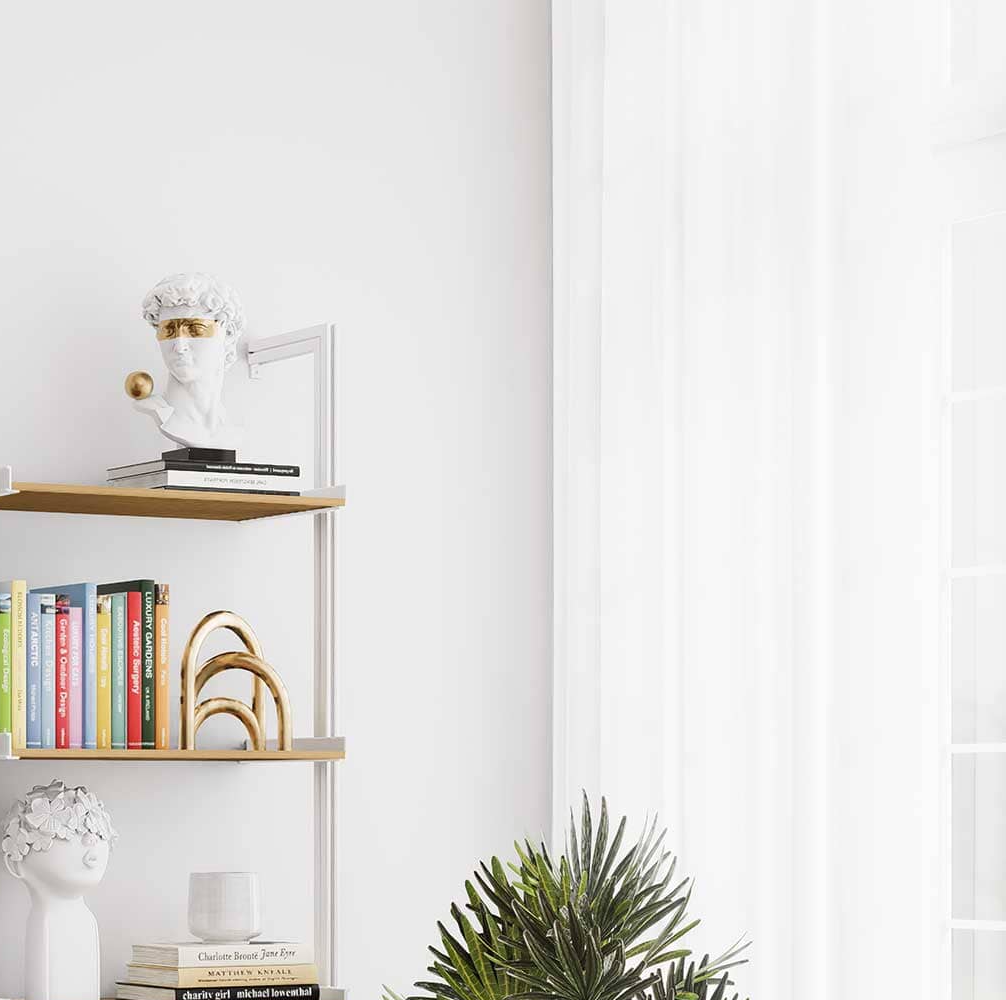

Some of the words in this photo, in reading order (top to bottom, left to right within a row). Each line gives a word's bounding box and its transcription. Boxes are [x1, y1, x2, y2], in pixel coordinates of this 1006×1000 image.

[30, 612, 38, 667] ANTARCTIC
[60, 619, 68, 646] Garden
[60, 656, 68, 689] Outdoor
[131, 659, 140, 694] Surgery
[59, 692, 68, 718] Design
[198, 952, 232, 961] Charlotte
[234, 951, 258, 960] Brontë
[261, 949, 278, 960] Jane
[280, 948, 296, 959] Eyre
[214, 990, 230, 1000] girl
[236, 988, 270, 998] michael
[271, 987, 312, 997] lowenthal
